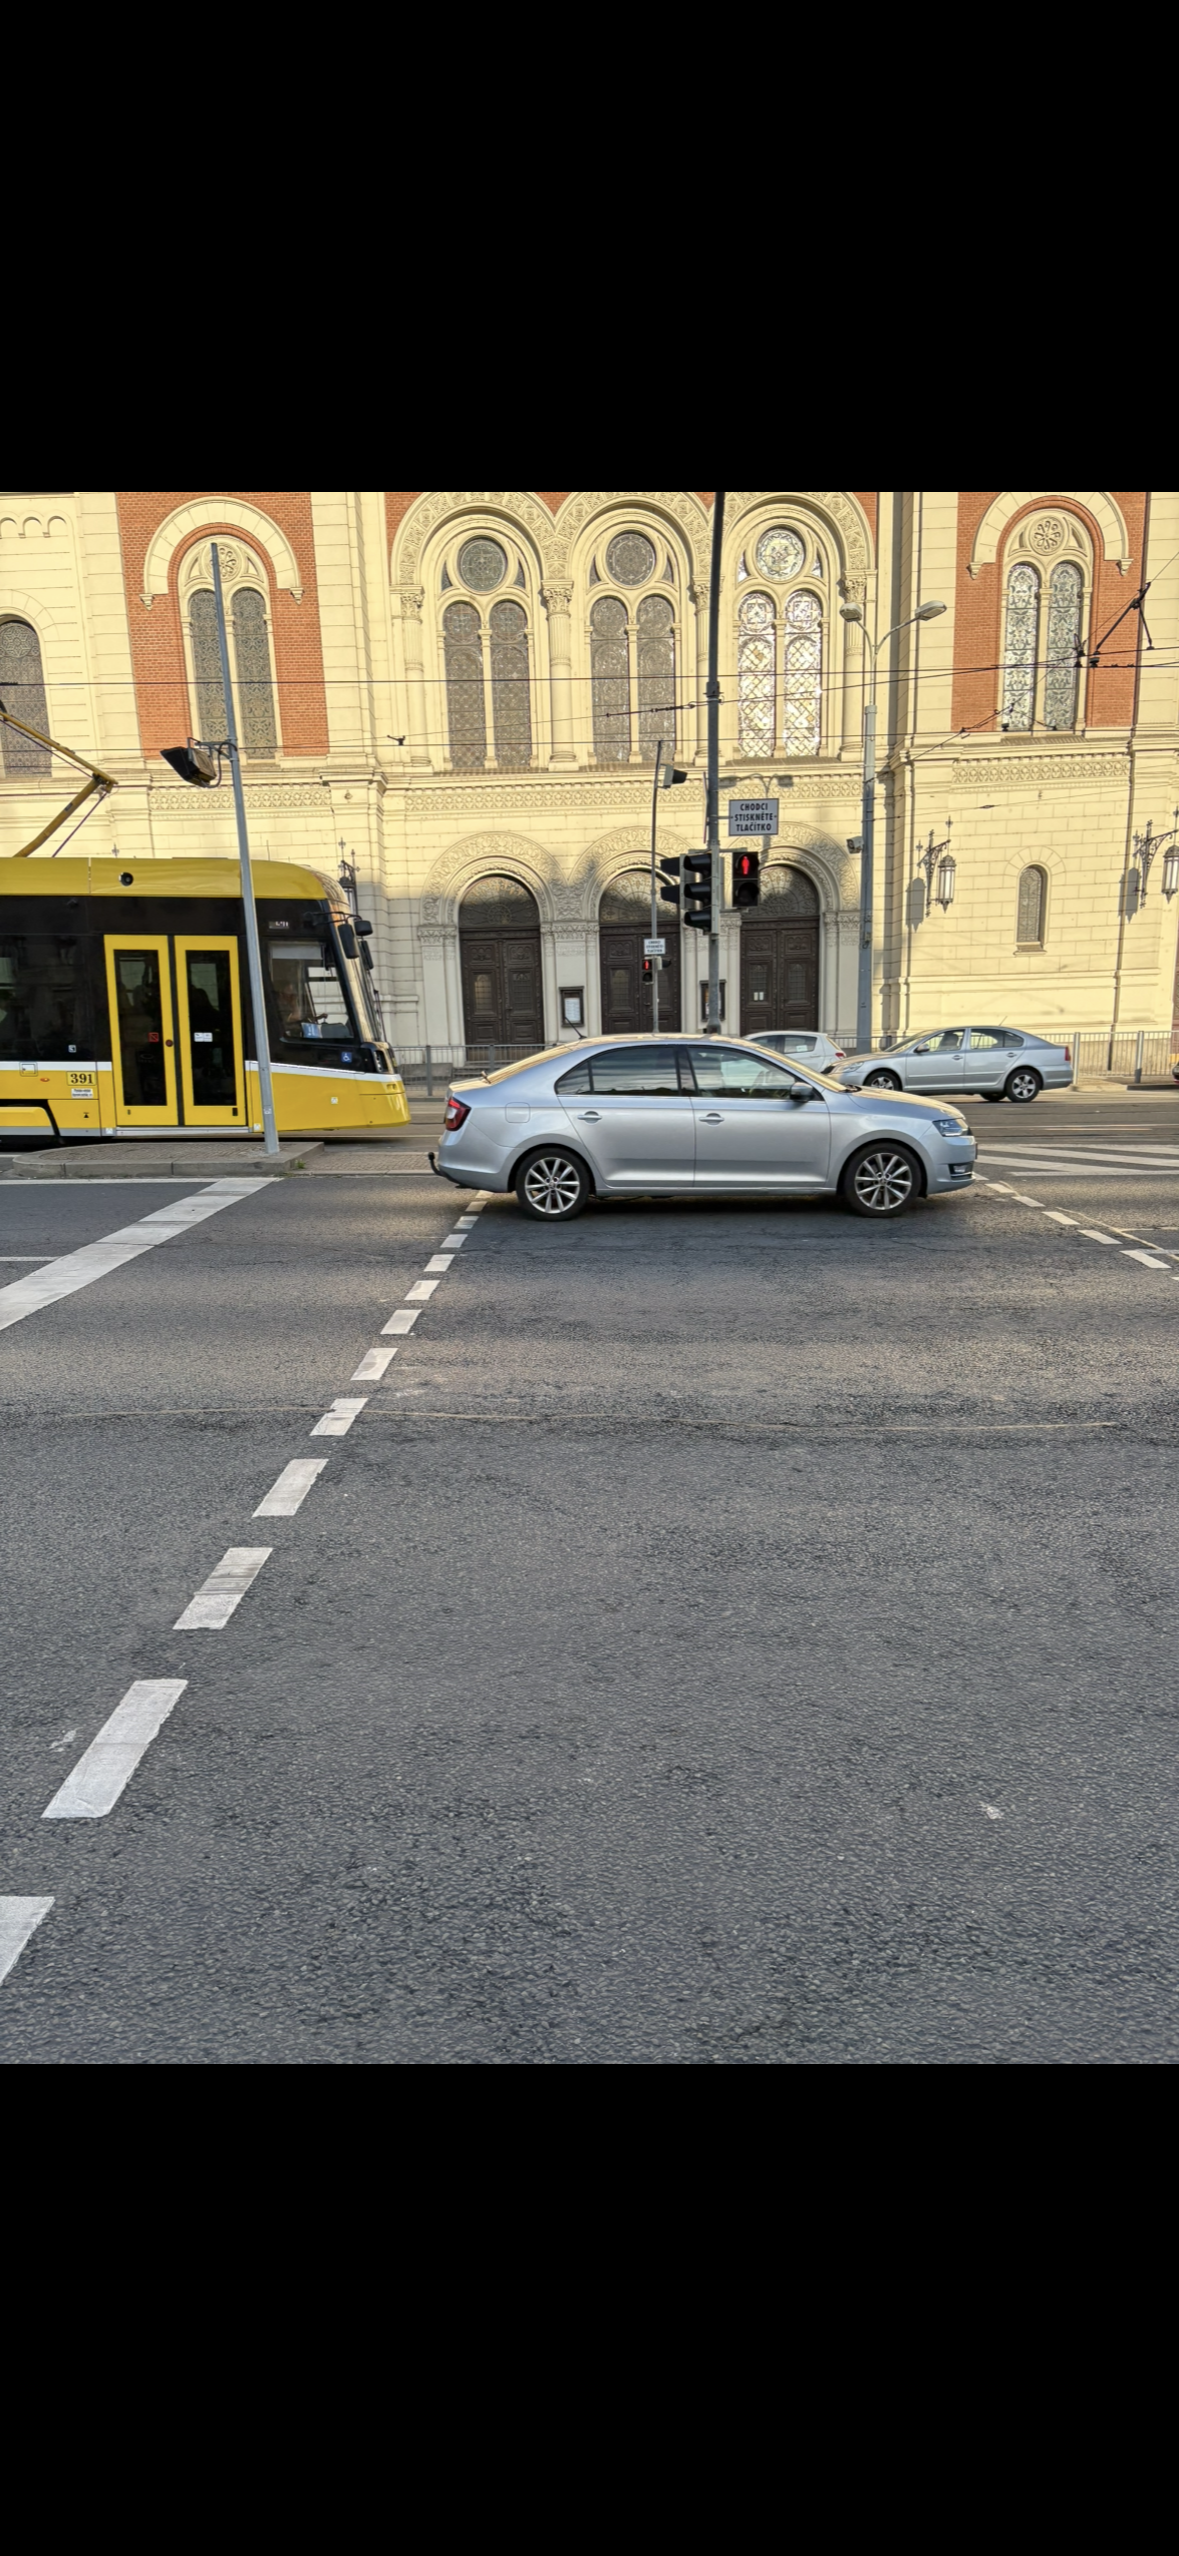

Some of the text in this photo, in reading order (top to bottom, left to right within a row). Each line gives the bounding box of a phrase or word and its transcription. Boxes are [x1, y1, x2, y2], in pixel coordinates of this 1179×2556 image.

[740, 803, 768, 811] CHODCI
[734, 812, 773, 821] STISKNĚTE
[736, 822, 771, 831] TLAČÍTKO
[70, 1073, 93, 1084] 391
